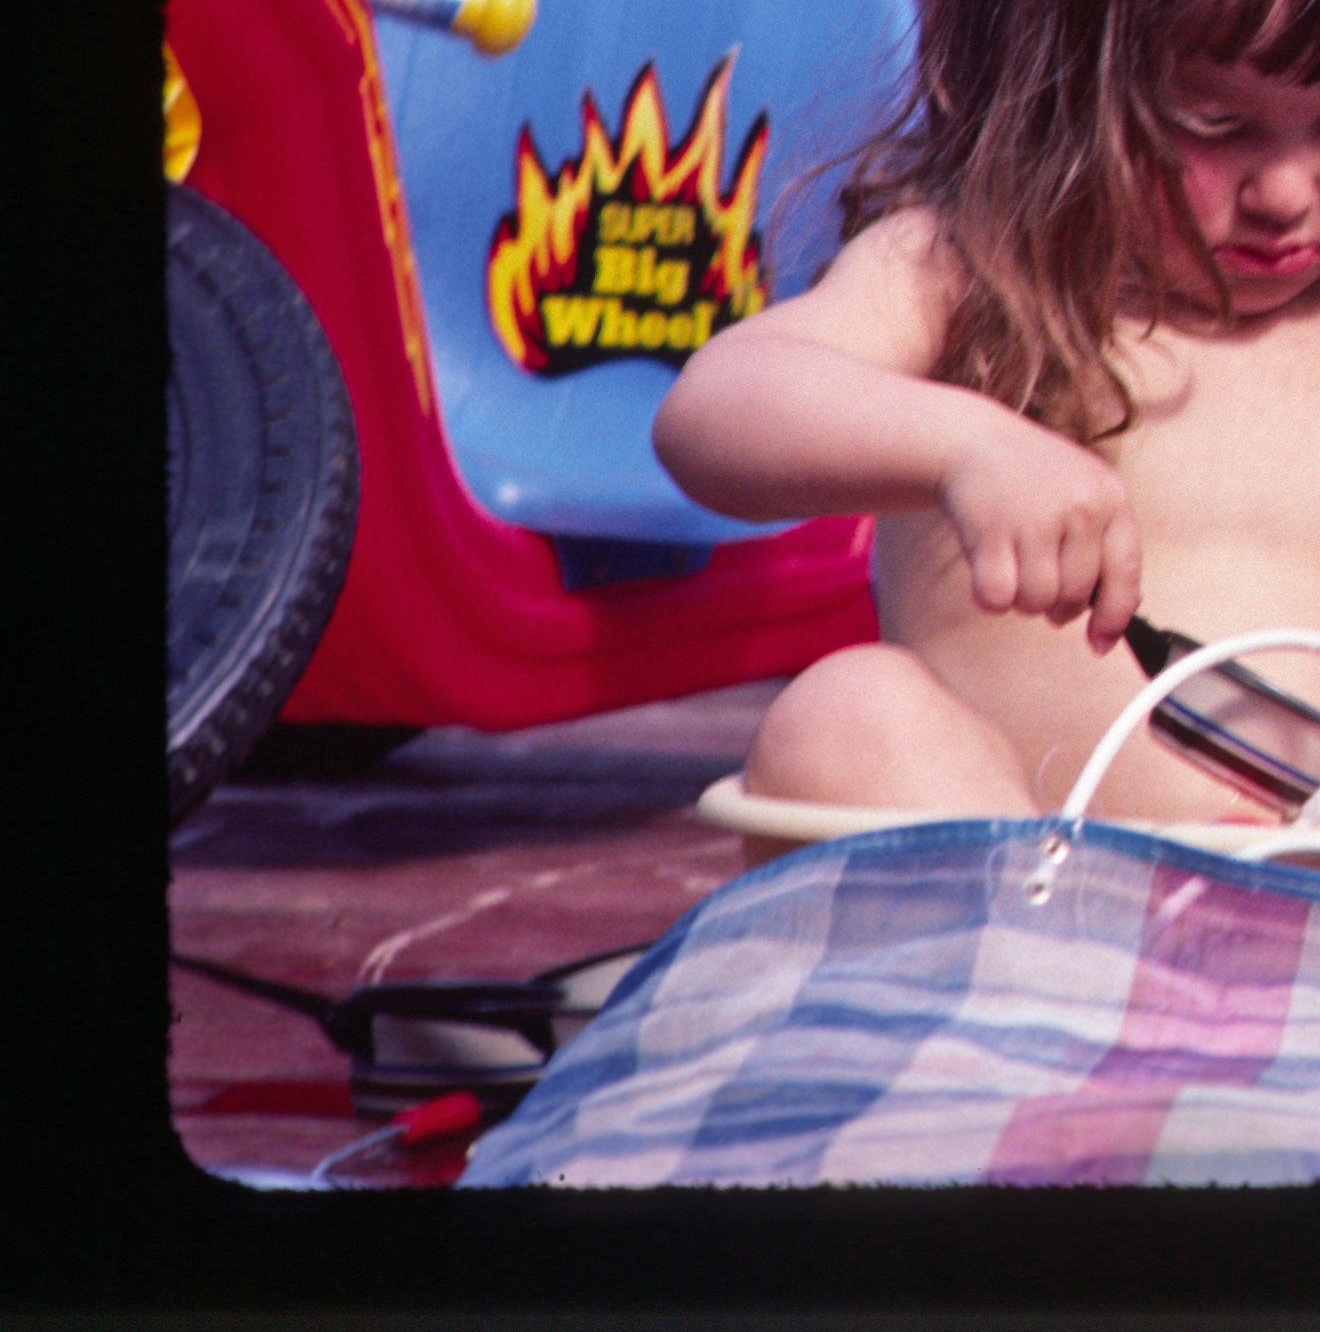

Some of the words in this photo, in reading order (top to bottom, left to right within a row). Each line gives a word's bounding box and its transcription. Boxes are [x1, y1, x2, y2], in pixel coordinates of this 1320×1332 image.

[601, 203, 696, 244] SUPER
[595, 246, 690, 305] Big
[542, 296, 716, 348] Wheel
